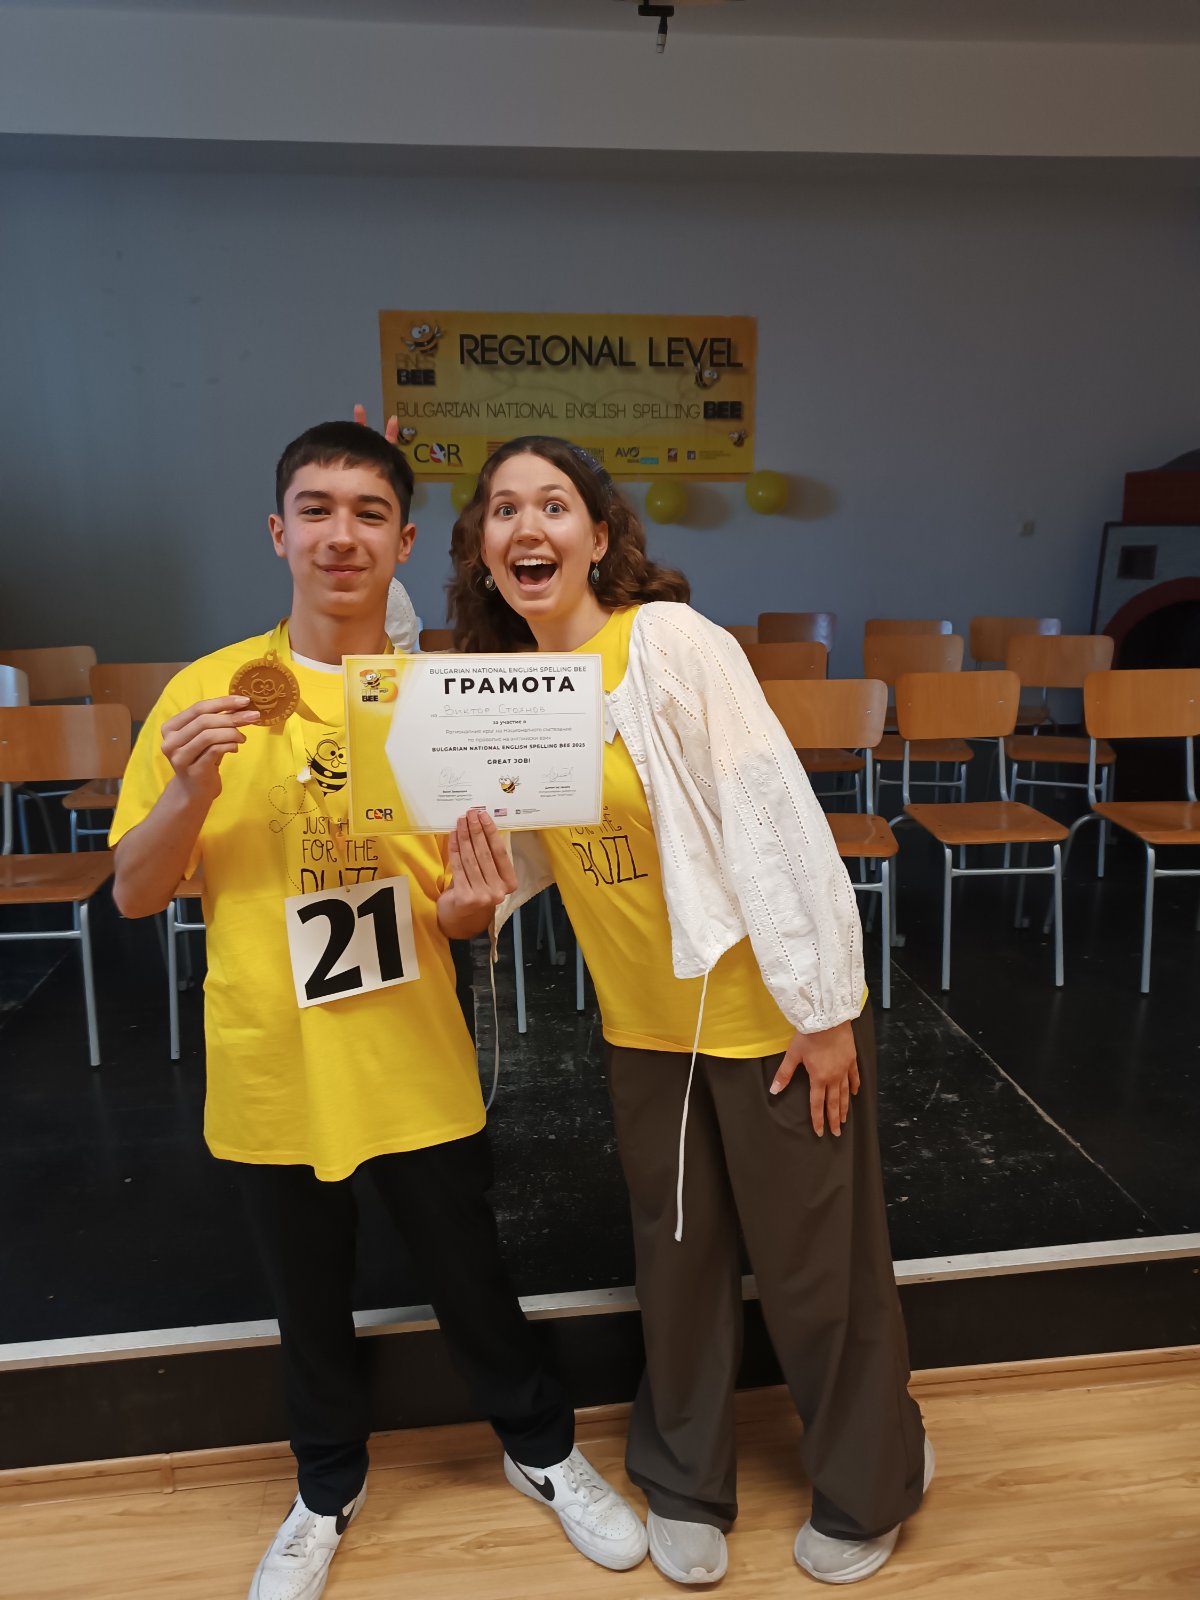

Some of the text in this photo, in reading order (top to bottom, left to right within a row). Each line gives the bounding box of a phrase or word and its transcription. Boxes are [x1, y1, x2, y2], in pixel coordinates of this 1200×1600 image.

[459, 333, 743, 368] REGIONAL LEVEL
[396, 368, 436, 386] BEE
[396, 400, 742, 420] BULGARIAN NATIONAL ENGLISH SPELLING BEE
[444, 676, 575, 695] ГРАМОТА
[302, 839, 379, 864] FOR THE
[296, 886, 405, 1001] 21
